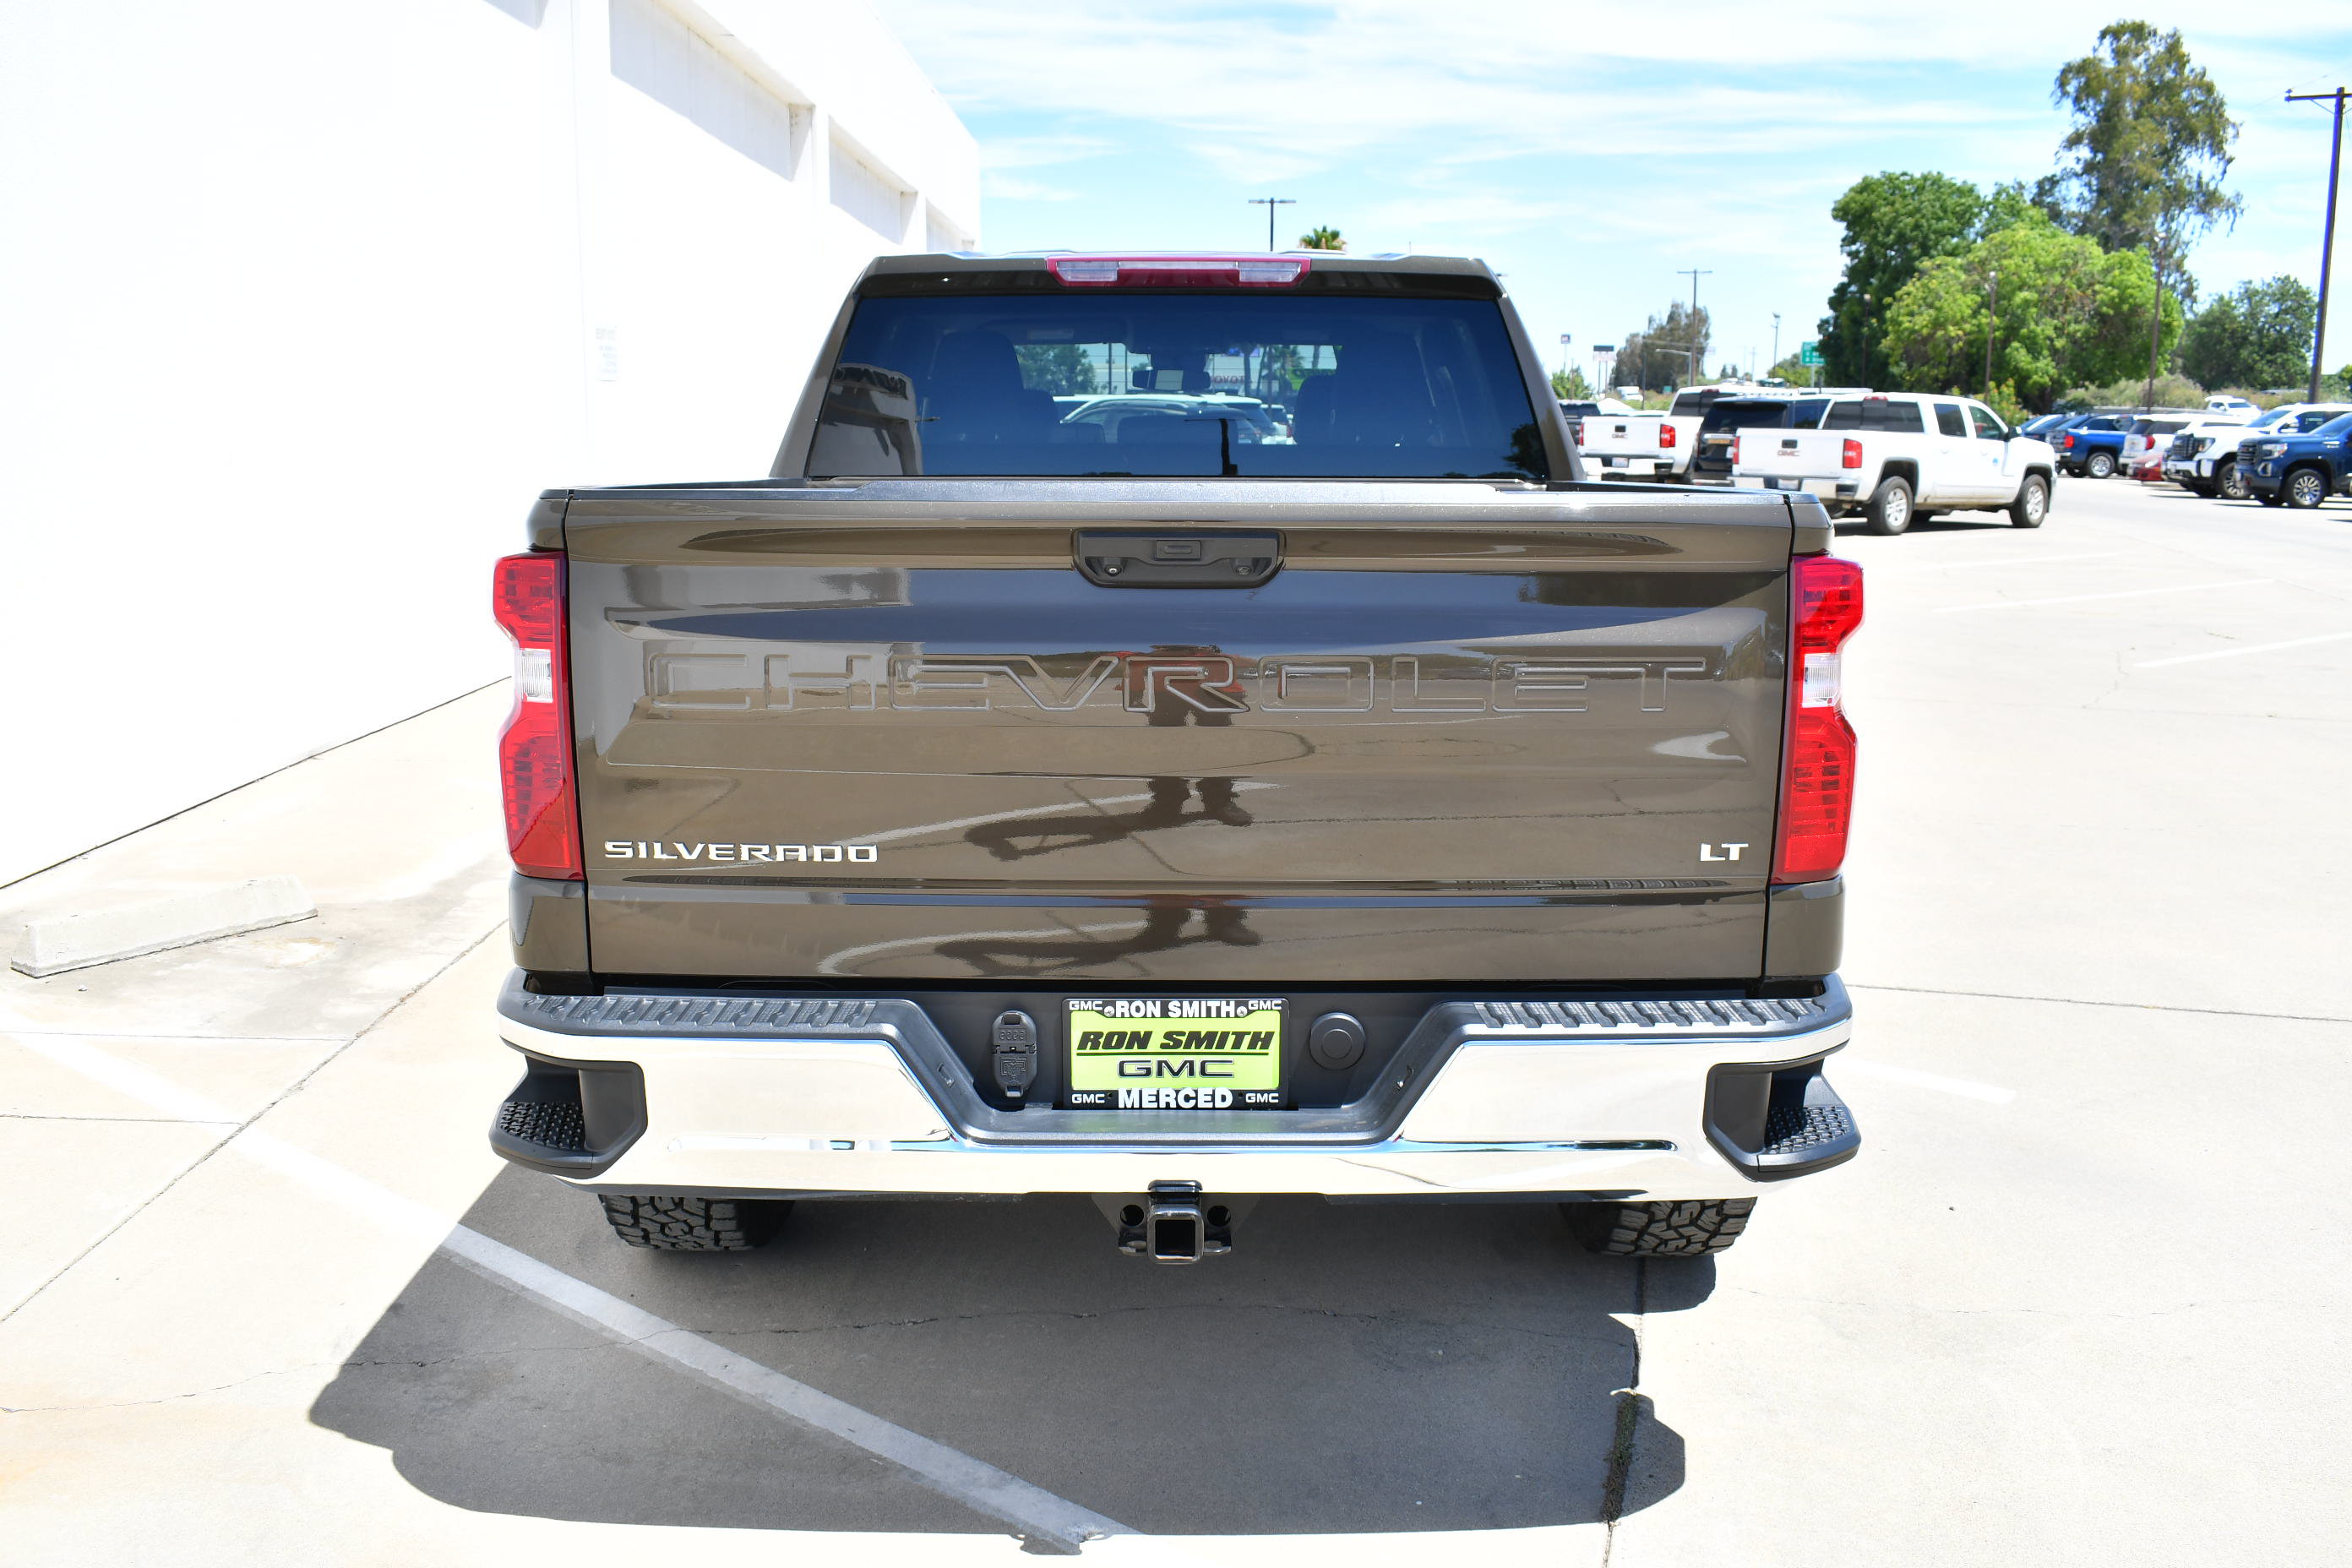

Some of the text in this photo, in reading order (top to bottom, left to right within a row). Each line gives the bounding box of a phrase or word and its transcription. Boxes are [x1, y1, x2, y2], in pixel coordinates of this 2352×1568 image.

[648, 653, 1707, 713] CHEVROLET
[604, 841, 879, 863] SILVERADO
[1700, 843, 1749, 862] LT
[1069, 1000, 1103, 1010] GMC
[1115, 1000, 1235, 1018] RON SMITH
[1248, 999, 1282, 1010] GMC
[1076, 1031, 1276, 1050] RON SMITH
[1117, 1059, 1235, 1079] GMC
[1071, 1093, 1105, 1104] GMC
[1118, 1087, 1233, 1108] MERCED
[1245, 1092, 1279, 1103] GMC
